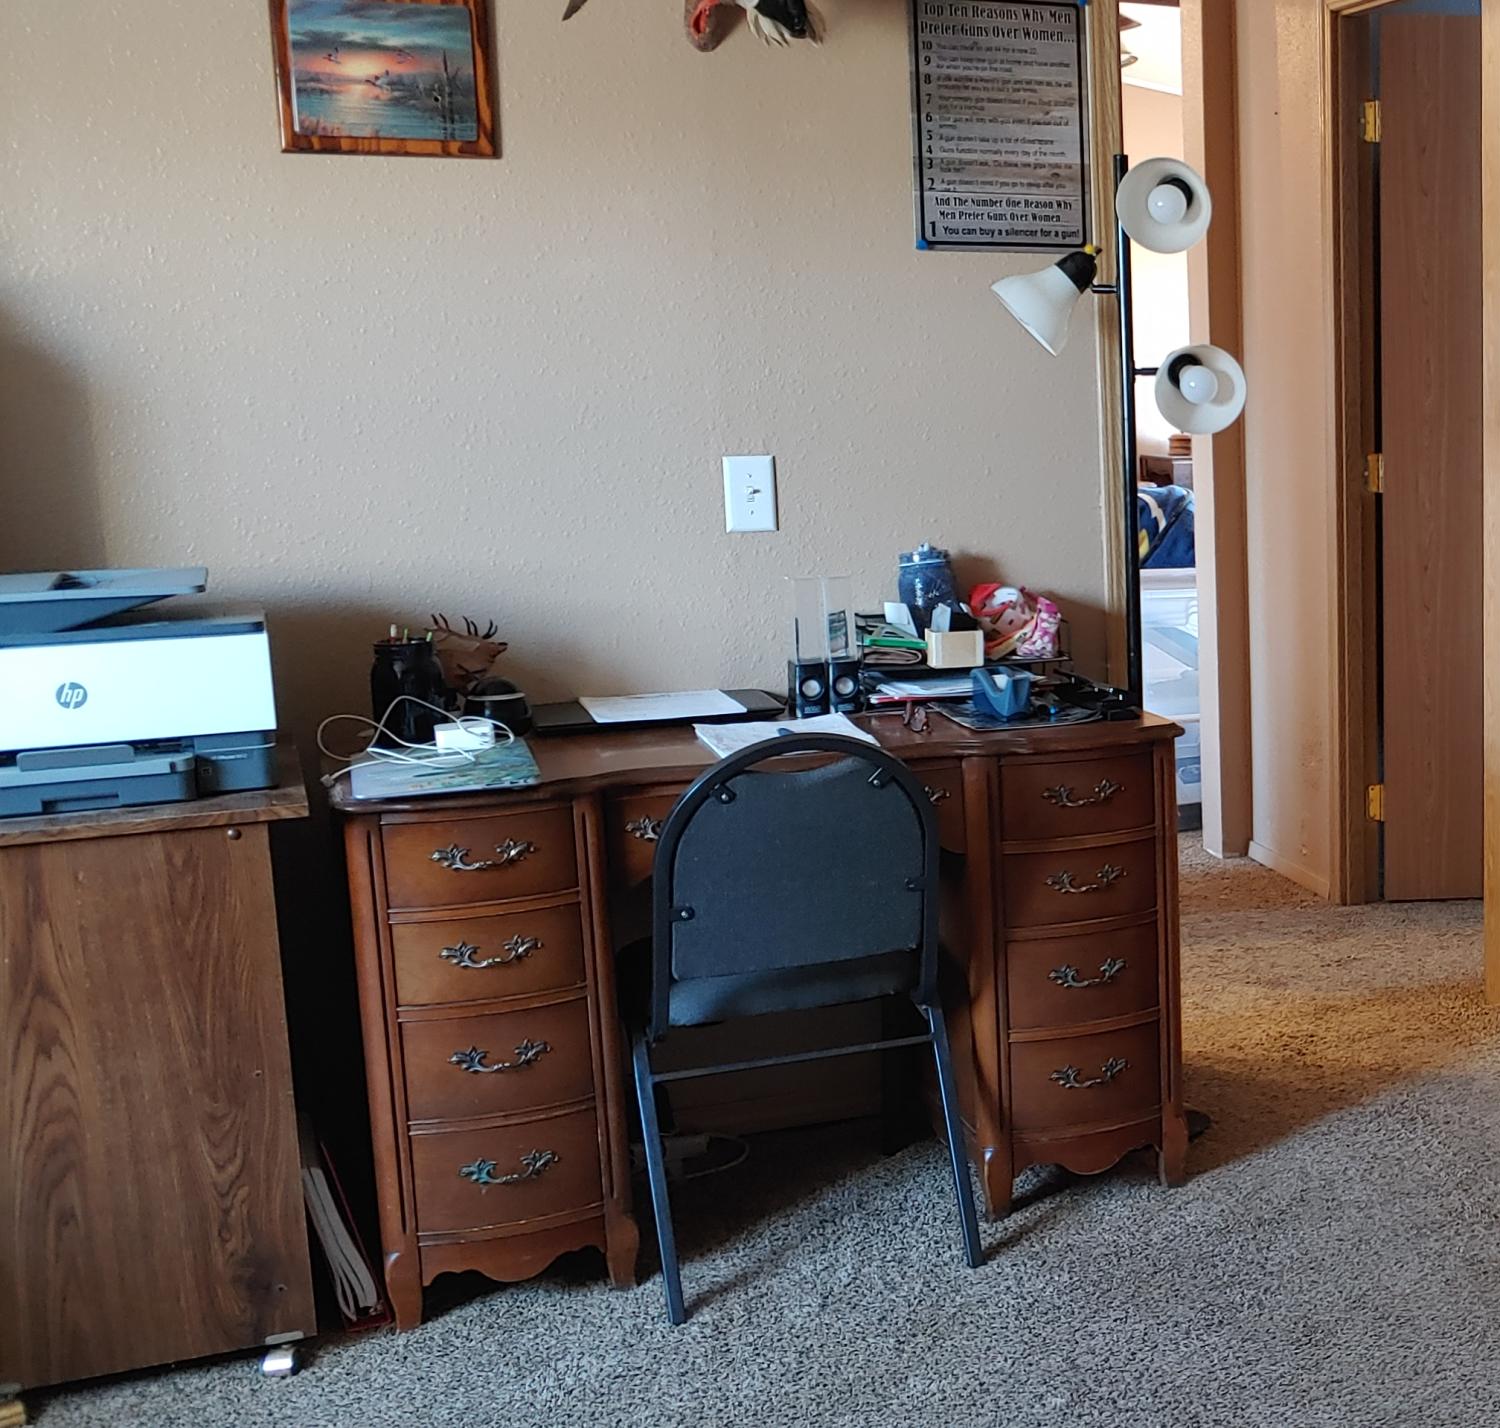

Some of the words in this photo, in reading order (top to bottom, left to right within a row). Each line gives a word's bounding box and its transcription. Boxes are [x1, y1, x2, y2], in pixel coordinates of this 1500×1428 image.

[923, 3, 944, 17] Top
[949, 4, 969, 18] Ten
[972, 5, 1019, 21] Reasons
[1021, 8, 1045, 24] Why
[1049, 10, 1072, 24] Men
[920, 21, 957, 36] Prefer
[960, 24, 990, 38] Guns
[992, 26, 1020, 39] Over
[921, 41, 933, 50] 10
[923, 55, 932, 66] 9
[923, 73, 932, 85] 8
[925, 93, 933, 105] 7
[925, 112, 934, 123] 6
[926, 130, 933, 141] 5
[925, 145, 934, 155] 4
[927, 158, 934, 170] 3
[927, 178, 936, 190] 2
[935, 197, 951, 207] And
[953, 197, 969, 208] The
[970, 197, 1003, 209] Number
[1005, 199, 1022, 210] One
[1024, 199, 1054, 211] Reason
[1055, 200, 1073, 212] Why
[938, 210, 956, 220] Men
[958, 211, 985, 221] Prefer
[987, 212, 1008, 222] Guns
[1009, 213, 1030, 222] Over
[929, 222, 936, 237] 1
[942, 226, 960, 236] You
[961, 227, 977, 236] can
[979, 226, 996, 239] buy
[1005, 227, 1038, 238] silencer
[1040, 227, 1053, 237] for
[1061, 227, 1080, 240] gun!
[60, 683, 85, 709] hp
